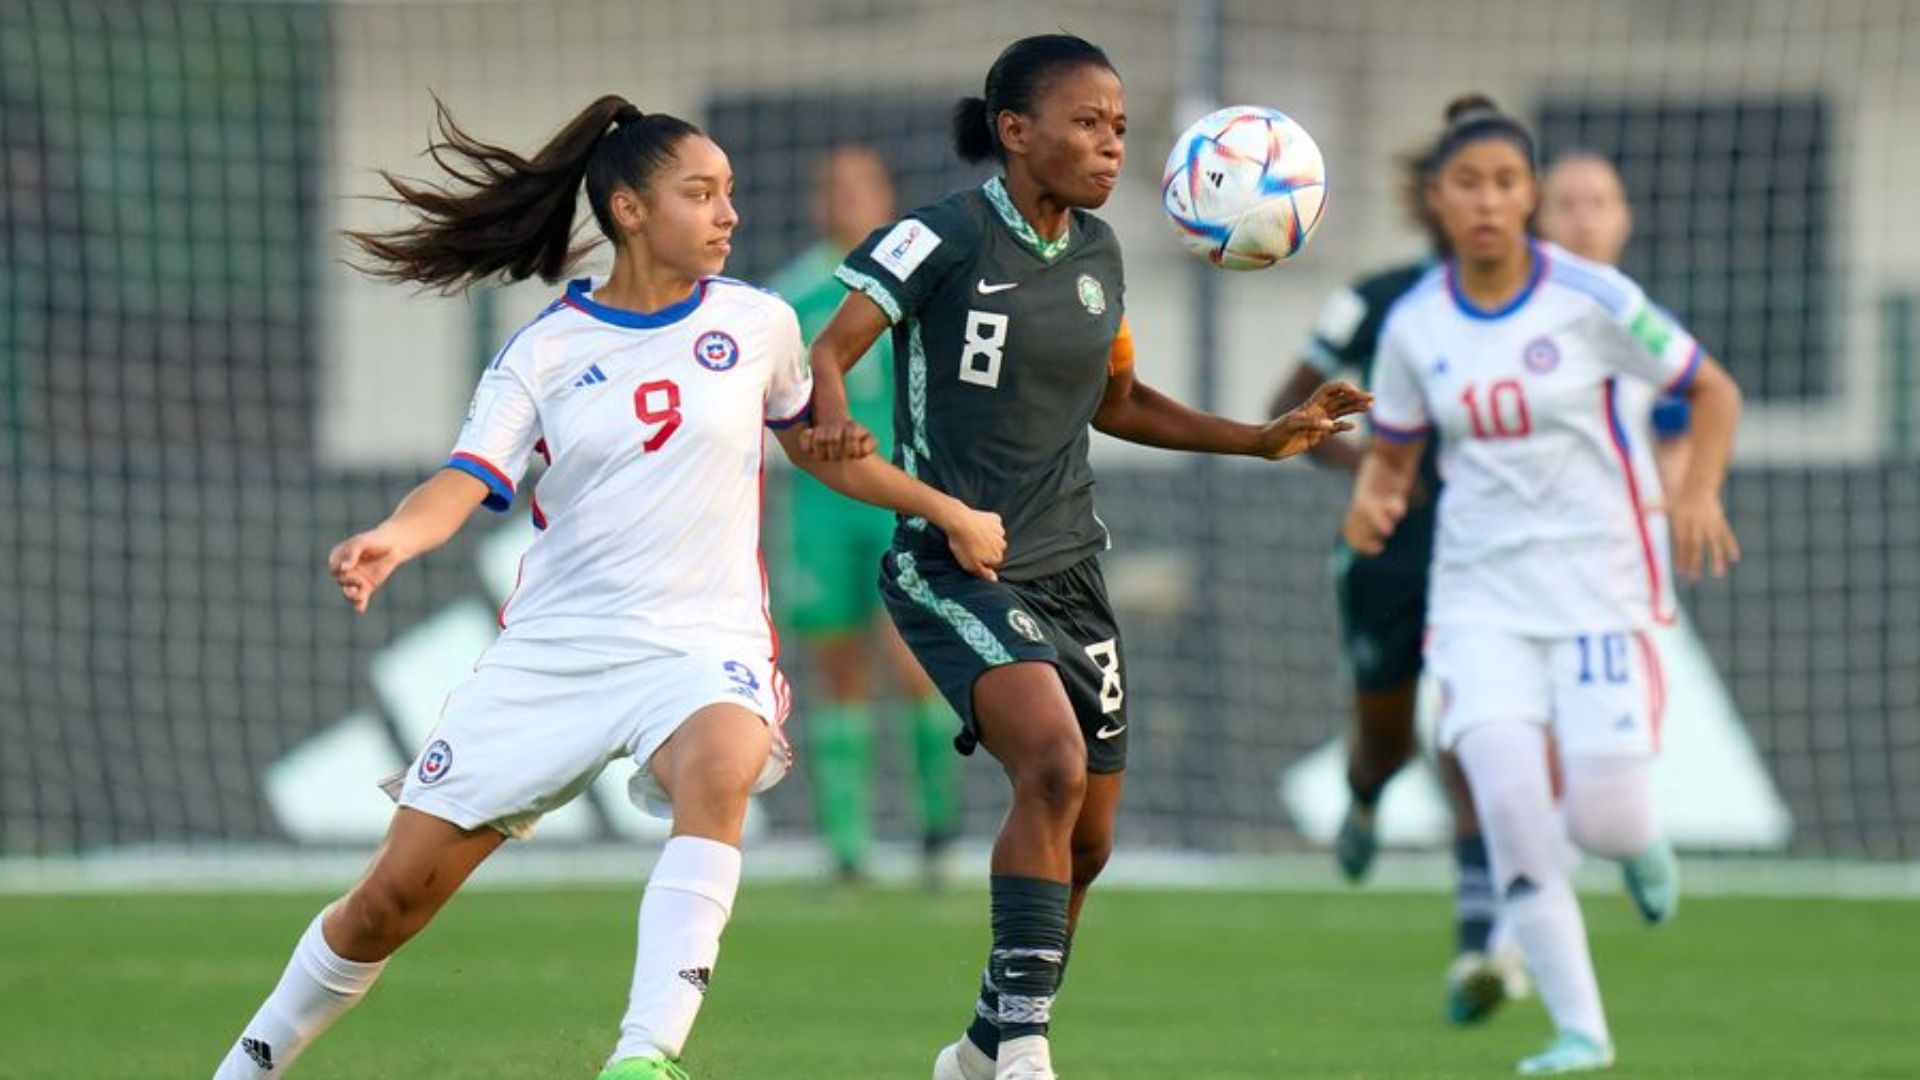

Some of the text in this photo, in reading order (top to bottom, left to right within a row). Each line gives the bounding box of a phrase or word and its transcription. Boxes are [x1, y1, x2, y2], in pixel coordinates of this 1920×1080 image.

[958, 309, 1009, 389] 8
[634, 379, 682, 453] 9
[1461, 380, 1531, 441] 10
[1084, 638, 1123, 714] 8
[1577, 633, 1628, 682] 10
